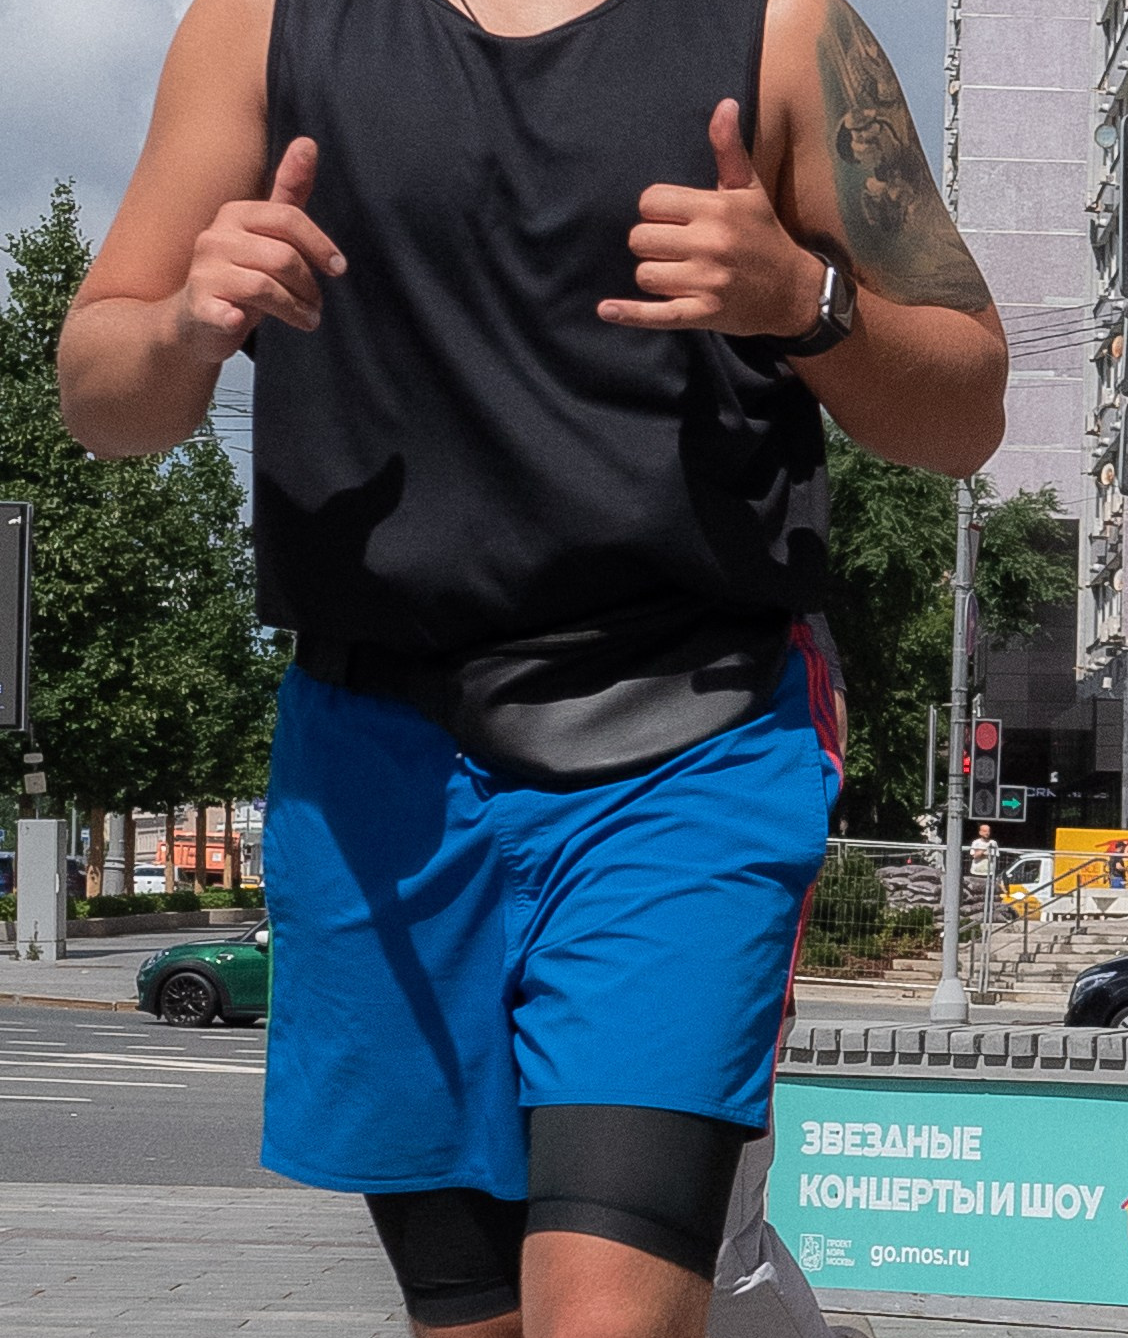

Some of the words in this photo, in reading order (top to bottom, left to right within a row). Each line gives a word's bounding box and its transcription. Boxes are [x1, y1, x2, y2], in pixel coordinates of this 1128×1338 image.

[800, 1121, 983, 1160] ЗВЕЗДНЫЕ
[799, 1173, 985, 1216] КОНЦЕРТЫ
[990, 1181, 1015, 1217] И
[1020, 1183, 1105, 1220] ШОУ
[826, 1239, 853, 1248] ПРОЕКТ
[870, 1245, 970, 1267] go.mos.ru
